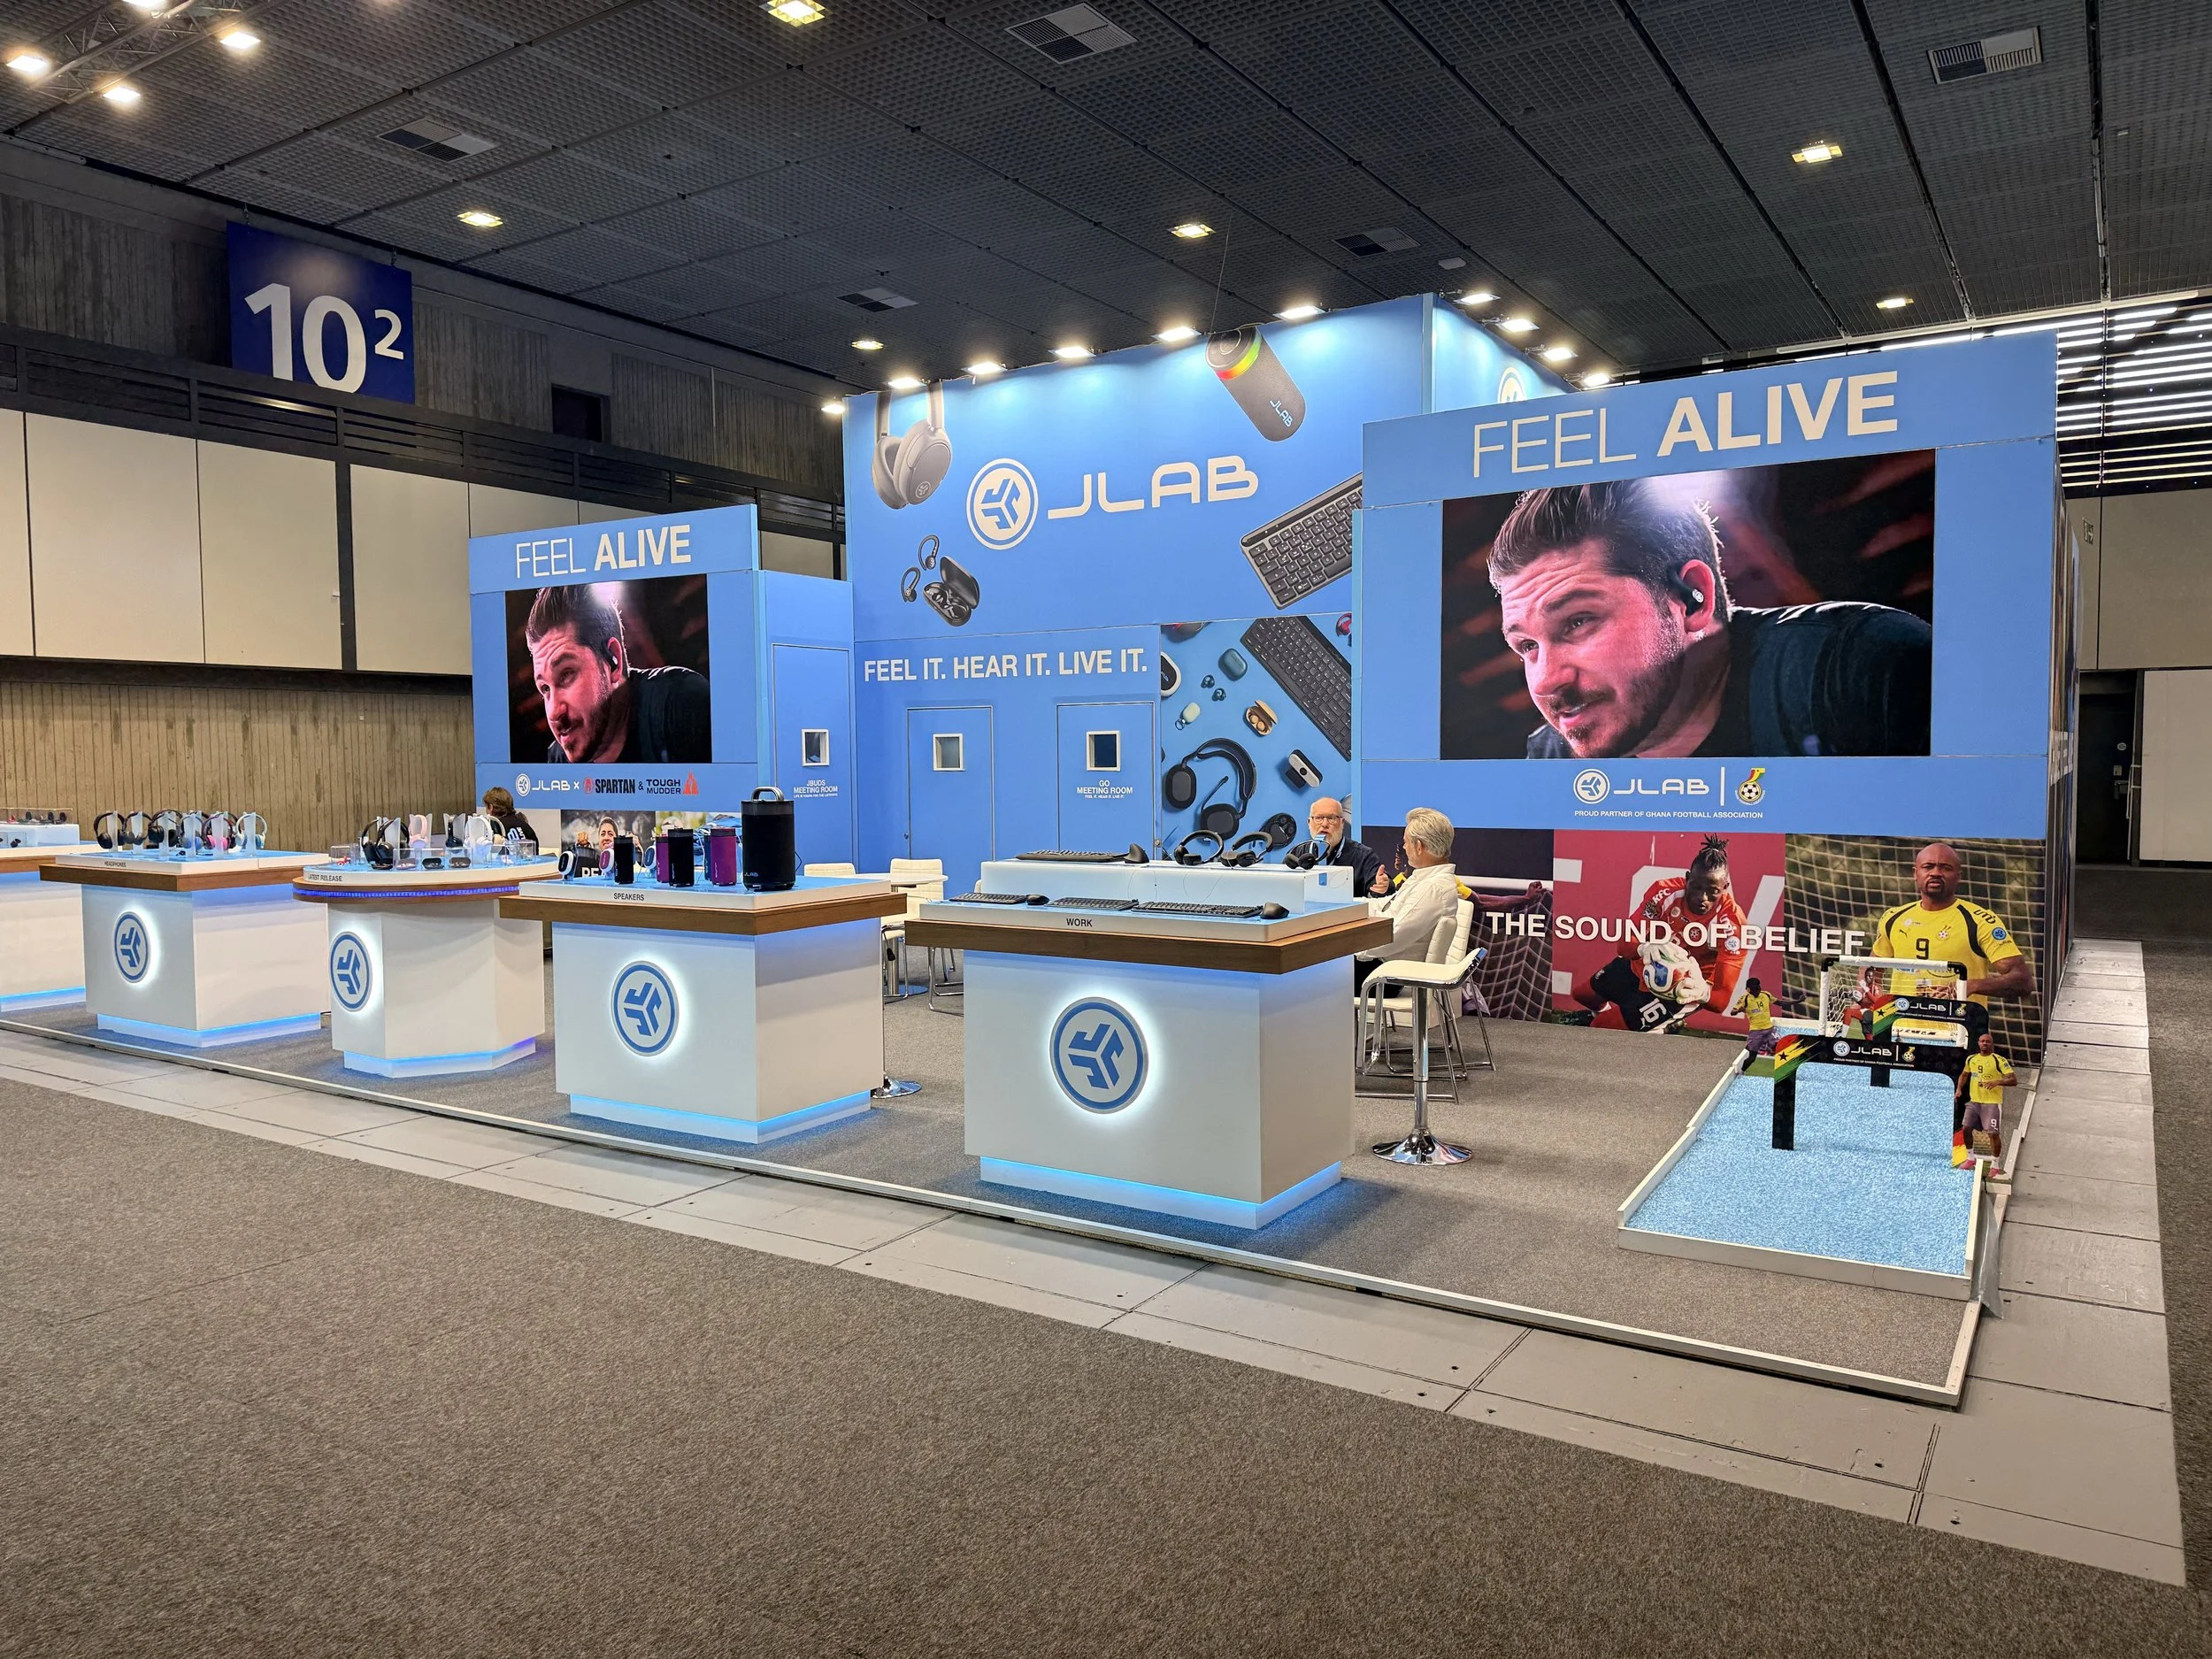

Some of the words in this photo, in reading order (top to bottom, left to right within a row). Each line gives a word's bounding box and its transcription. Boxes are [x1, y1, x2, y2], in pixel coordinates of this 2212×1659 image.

[1269, 400, 1293, 427] JLAB
[1473, 407, 1637, 478] FEEL
[1656, 370, 1898, 457] ALIVE
[1048, 455, 1259, 519] JLAB
[516, 537, 586, 578] FEEL
[594, 524, 691, 571] ALIVE
[864, 658, 917, 681] FEEL
[923, 657, 946, 680] IT.
[953, 655, 1018, 679] HEAR
[1025, 652, 1050, 677] IT.
[1059, 649, 1111, 675] LIVE
[1120, 648, 1148, 672] IT.
[532, 780, 570, 791] JLAB
[595, 779, 635, 795] SPARTAN
[638, 780, 644, 791] &
[1613, 778, 1709, 795] JLAB
[613, 892, 645, 901] SPEAKERS
[1652, 887, 1671, 904] KFC
[1066, 918, 1093, 927] WORK
[1486, 911, 1546, 938] THE
[1555, 915, 1672, 944] SOUND
[1683, 921, 1728, 948] OF
[1740, 925, 1865, 956] BELIEF
[1916, 938, 1930, 960] 9
[1639, 997, 1667, 1023] 16
[1910, 1002, 1947, 1011] JLAB
[1851, 1047, 1893, 1056] JLAB
[1978, 1064, 1984, 1073] 9
[1991, 1118, 1997, 1127] 9
